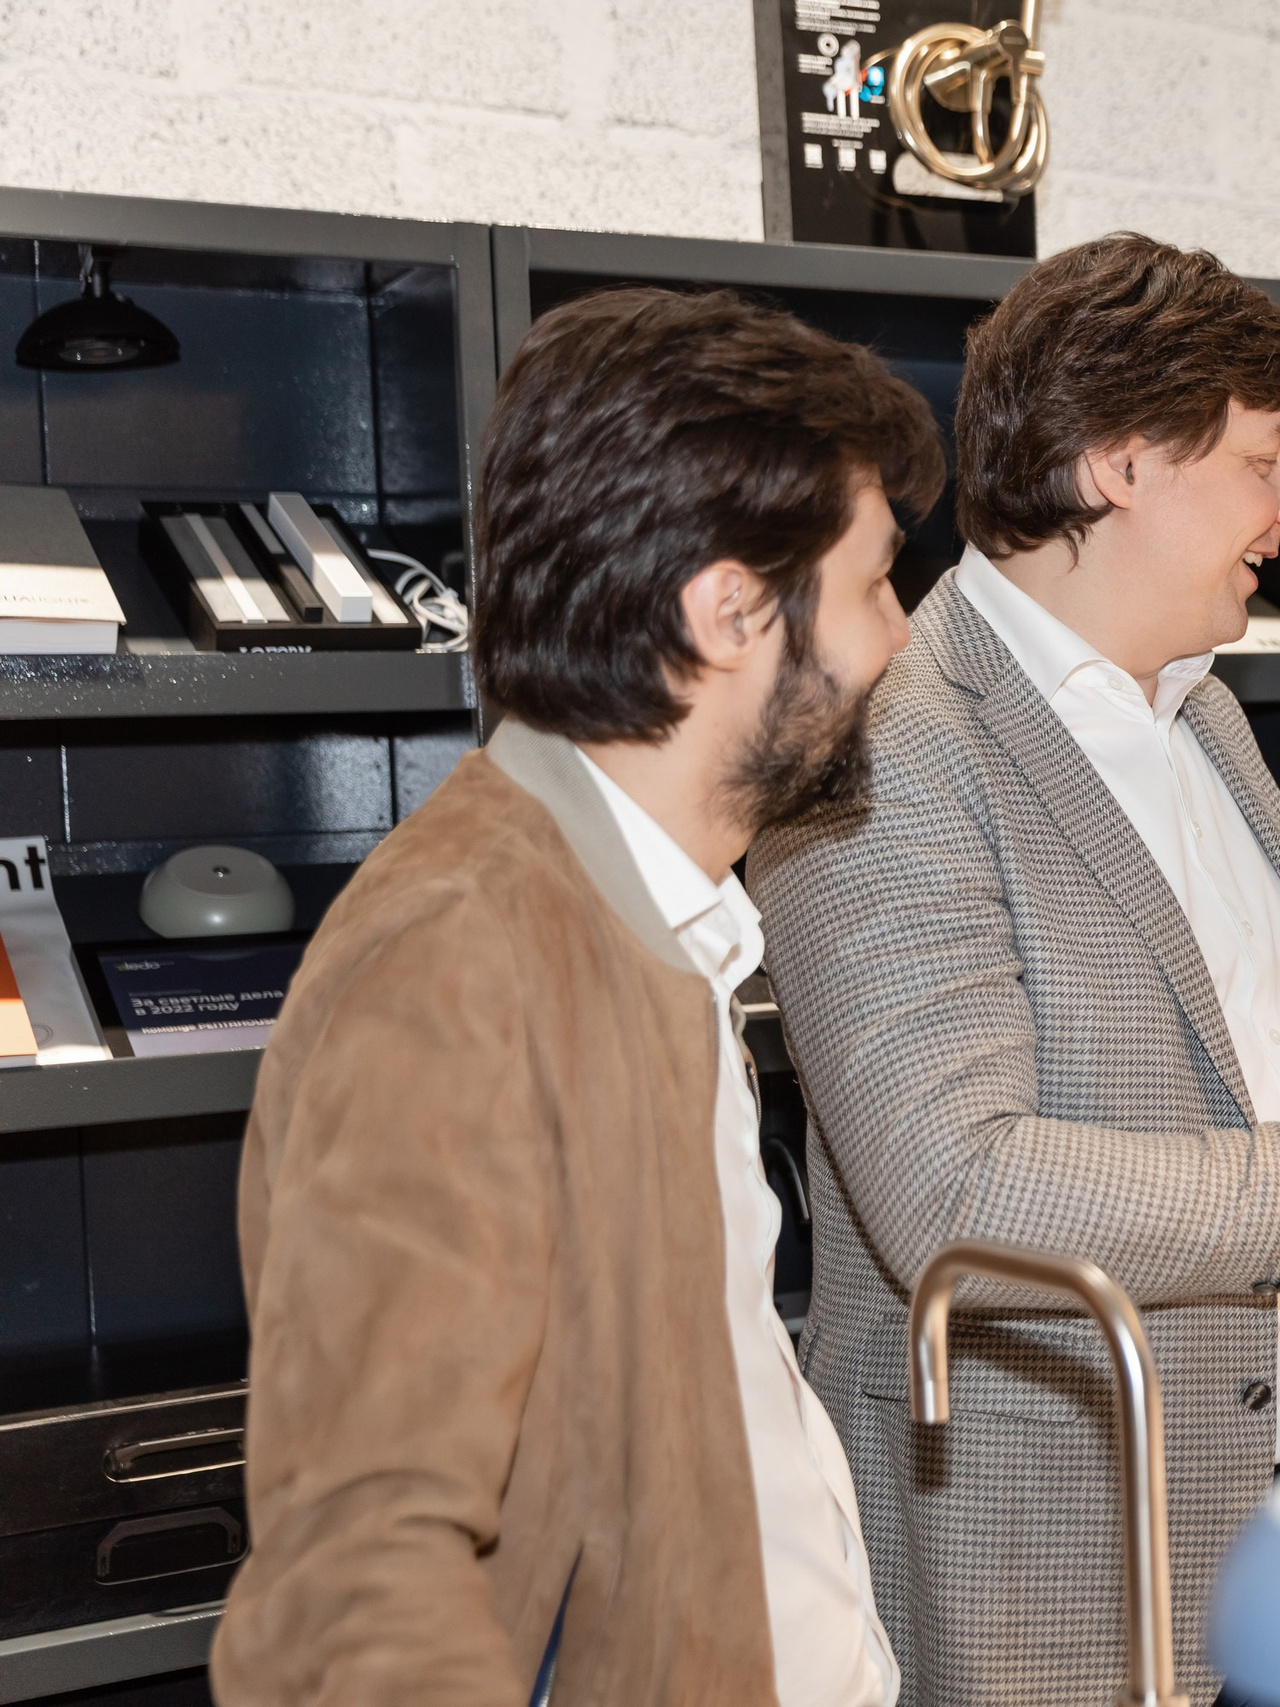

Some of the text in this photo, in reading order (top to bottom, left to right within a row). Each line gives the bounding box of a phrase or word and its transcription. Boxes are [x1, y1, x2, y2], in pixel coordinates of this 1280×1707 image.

[131, 990, 285, 1008] За светлые дела
[151, 1004, 194, 1015] 2022
[198, 1001, 240, 1012] году
